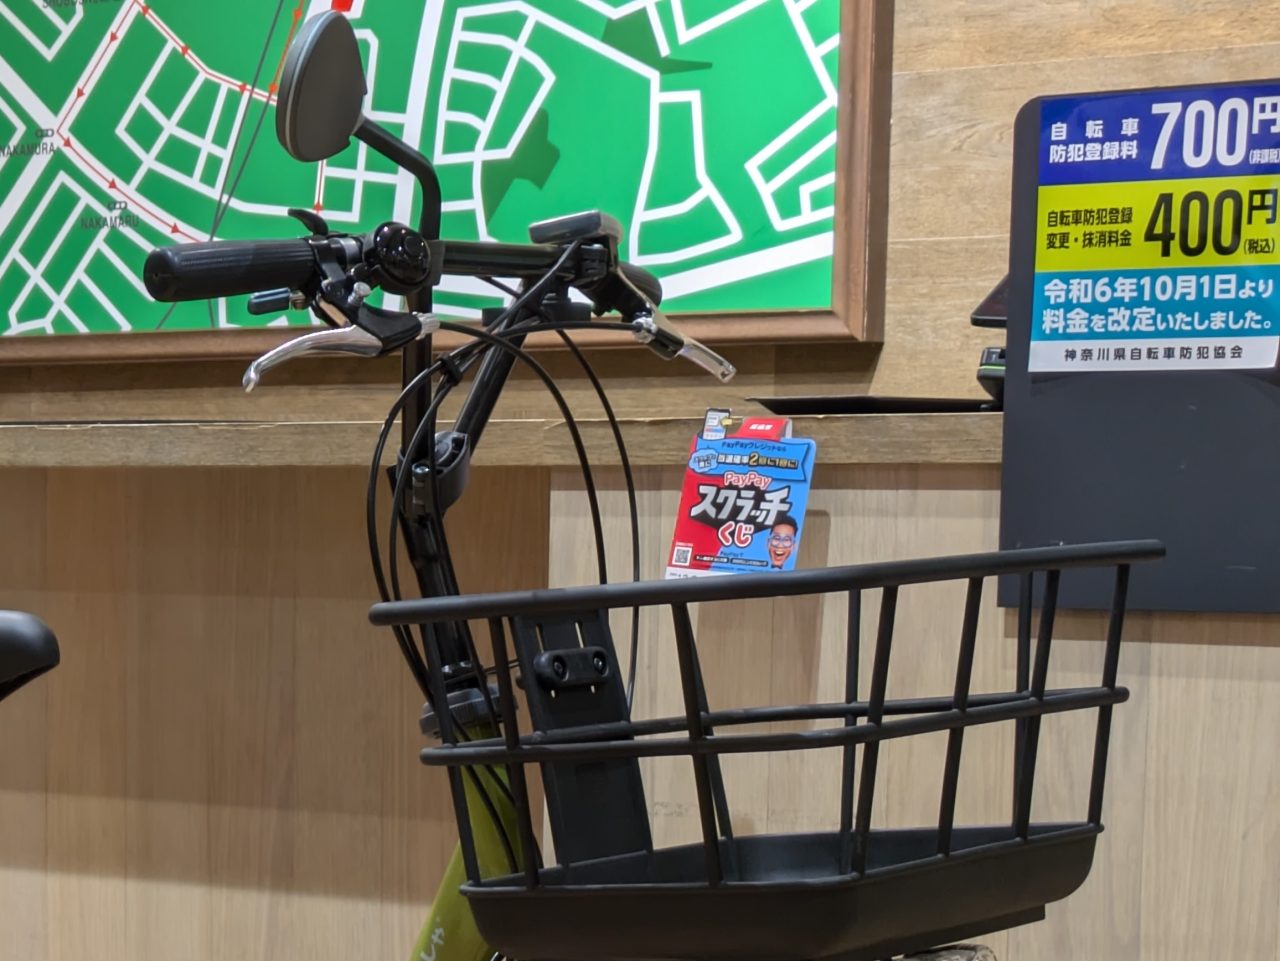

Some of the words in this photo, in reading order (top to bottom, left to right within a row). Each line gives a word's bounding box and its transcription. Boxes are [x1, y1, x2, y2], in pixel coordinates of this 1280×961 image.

[1049, 141, 1138, 163] 防犯登録料
[1046, 206, 1133, 228] 自転車防犯登録
[1143, 189, 1278, 258] 400円
[1046, 229, 1133, 250] 変更・抹消料金
[1243, 238, 1275, 255] (税込)
[1043, 273, 1274, 305] 令和6年10月1日より
[1042, 306, 1272, 335] 料金を改定いたしました。
[1064, 345, 1243, 361] 神奈川県自転車防犯協会
[724, 472, 771, 490] PayPay
[690, 485, 791, 526] スクラッチ
[719, 521, 754, 547] くじ
